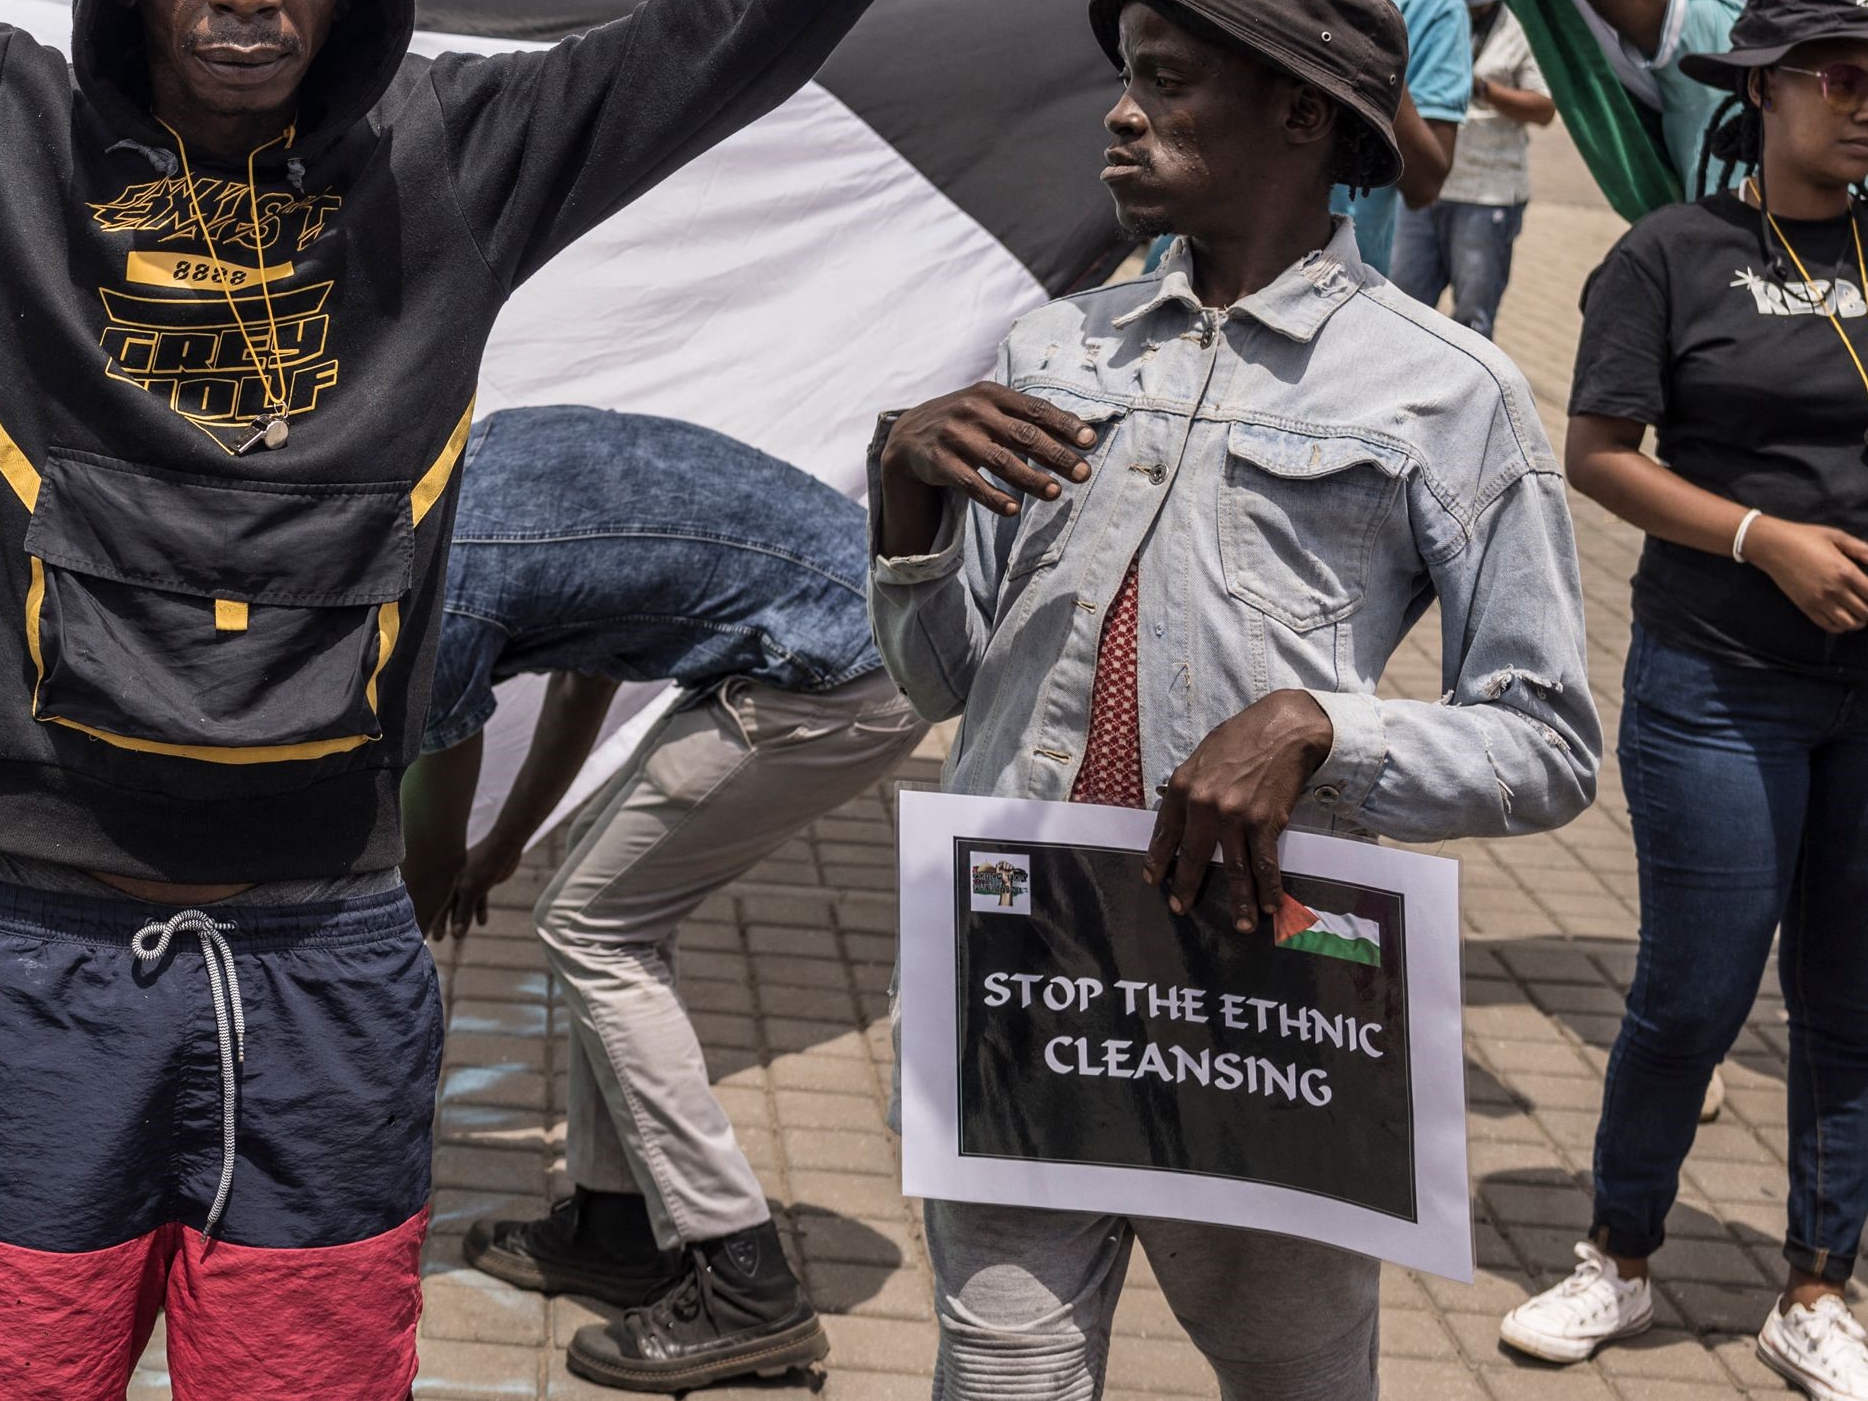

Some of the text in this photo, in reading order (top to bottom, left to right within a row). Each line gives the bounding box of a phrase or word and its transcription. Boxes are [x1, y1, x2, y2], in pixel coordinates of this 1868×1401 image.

[85, 172, 342, 252] EXIST
[99, 314, 330, 374] GREY
[983, 972, 1384, 1059] STOP THE ETHNIC
[1044, 1035, 1333, 1107] CLEANSING
